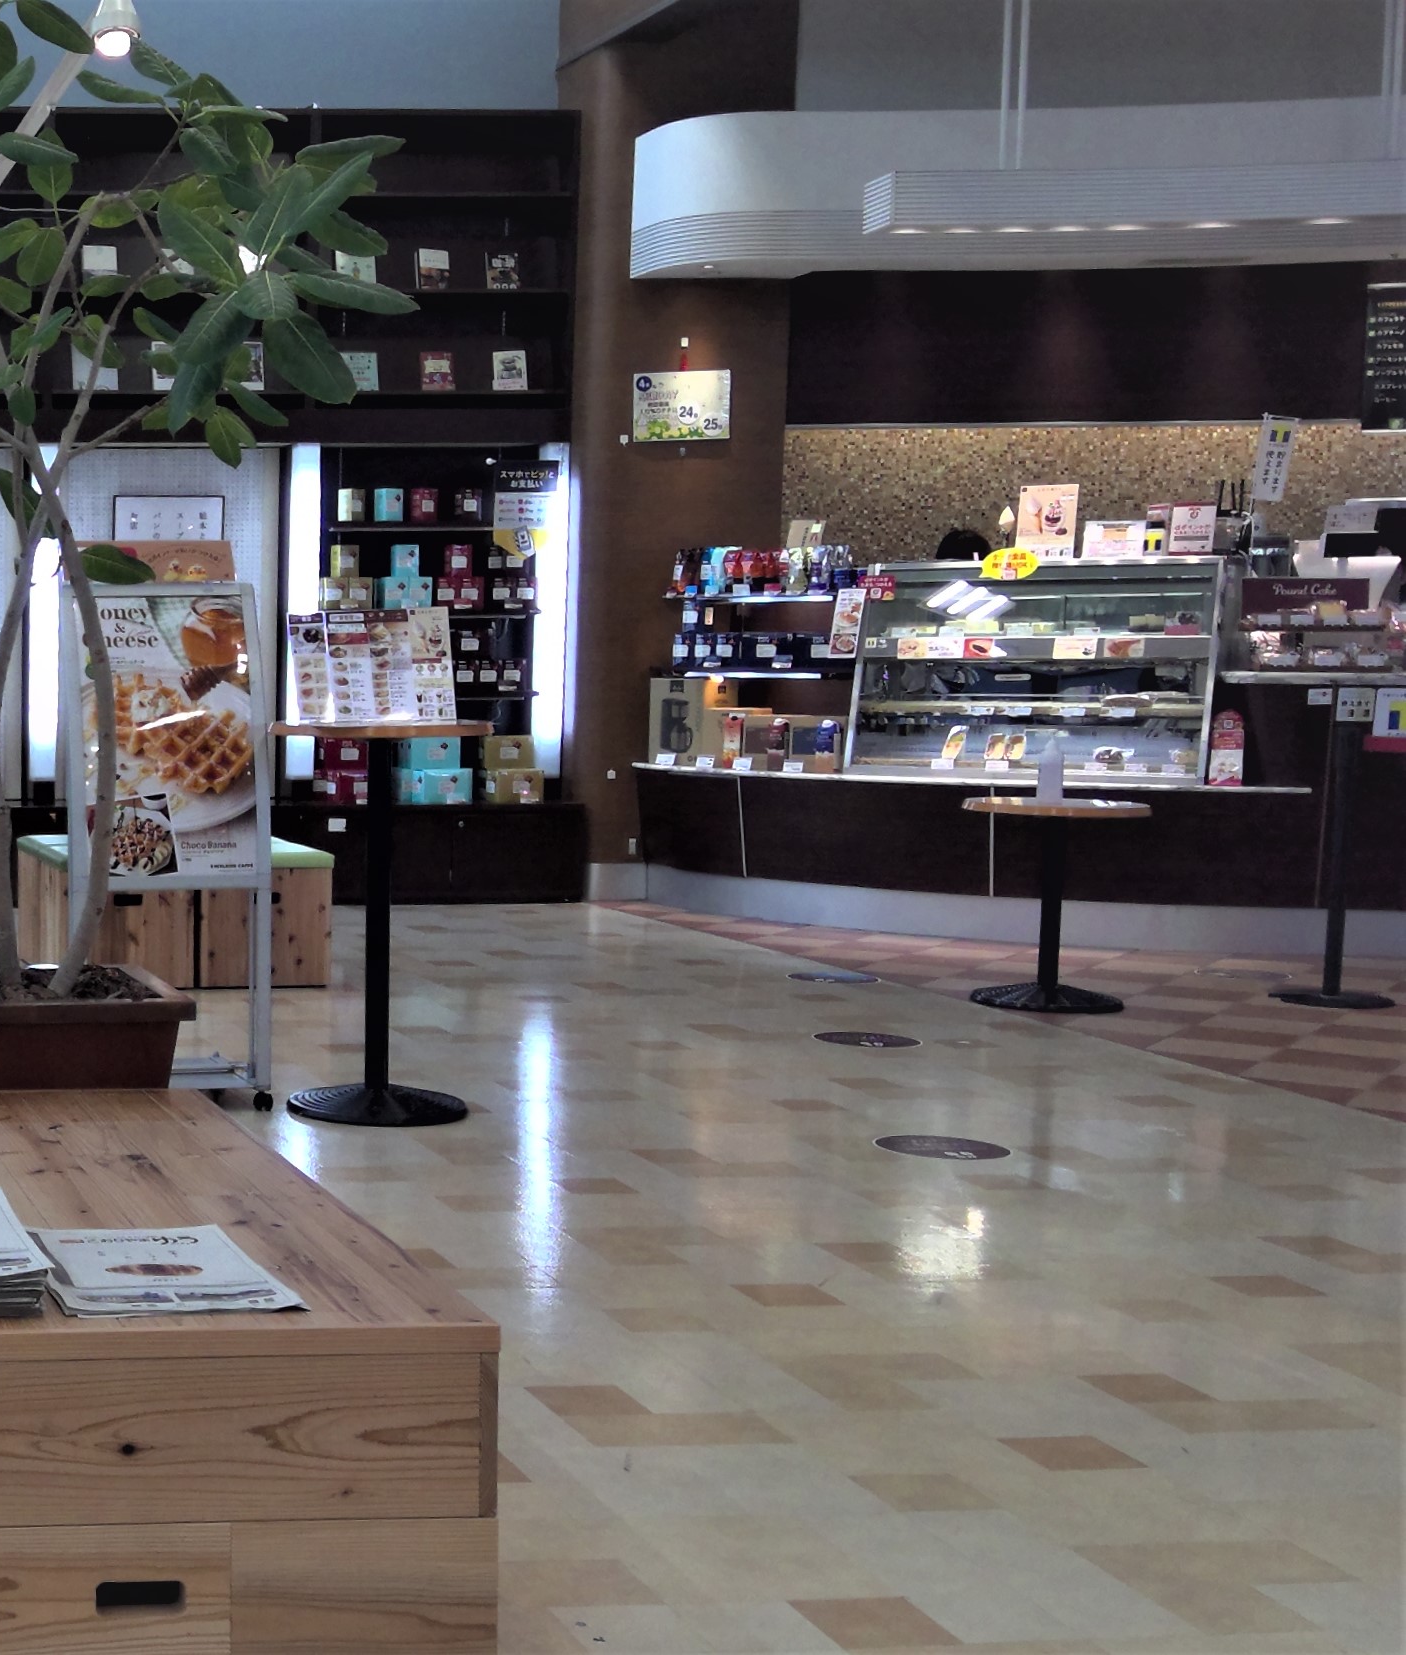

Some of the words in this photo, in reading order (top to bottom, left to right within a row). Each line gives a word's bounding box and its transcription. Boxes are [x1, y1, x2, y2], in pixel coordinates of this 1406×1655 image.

[510, 479, 544, 489] お支払い
[1272, 583, 1309, 596] Pound
[1310, 583, 1338, 596] Cake
[99, 607, 150, 626] oney
[114, 622, 126, 634] &
[207, 840, 237, 849] Banana
